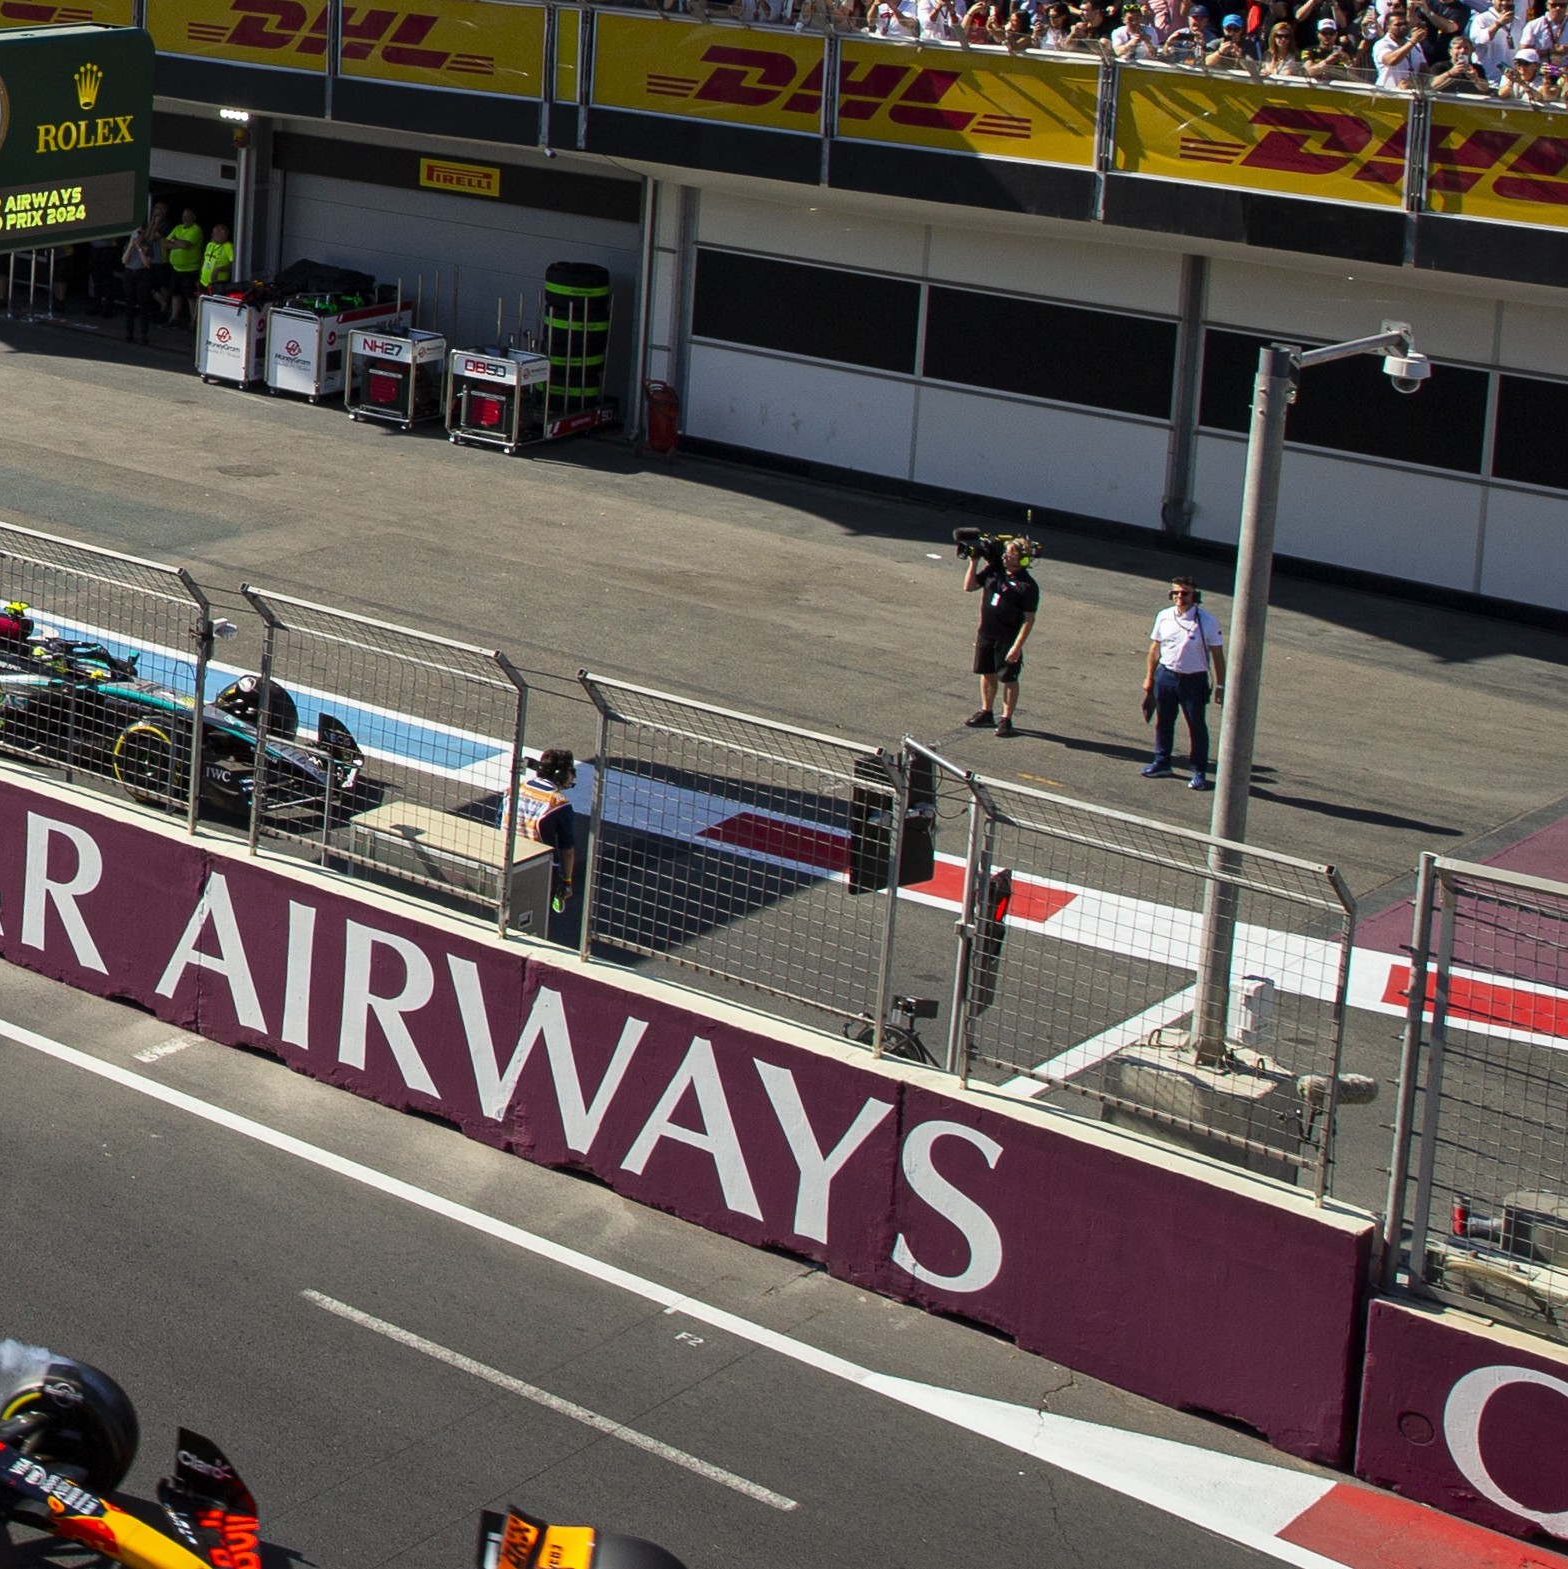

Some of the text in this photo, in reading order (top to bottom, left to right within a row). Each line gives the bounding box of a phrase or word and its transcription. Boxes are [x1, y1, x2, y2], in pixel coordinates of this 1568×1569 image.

[691, 44, 976, 132] DHL
[35, 115, 135, 154] ROLEX
[1241, 105, 1568, 206] DHL
[426, 164, 493, 191] PIRELLI
[4, 187, 83, 213] AIRWAYS
[6, 209, 43, 231] PRIX
[47, 204, 86, 225] 2024
[274, 352, 312, 366] MoneyGram
[362, 337, 403, 357] NH27
[205, 766, 233, 783] IWC
[154, 871, 1004, 1293] AIRWAYS
[674, 1331, 705, 1348] F2
